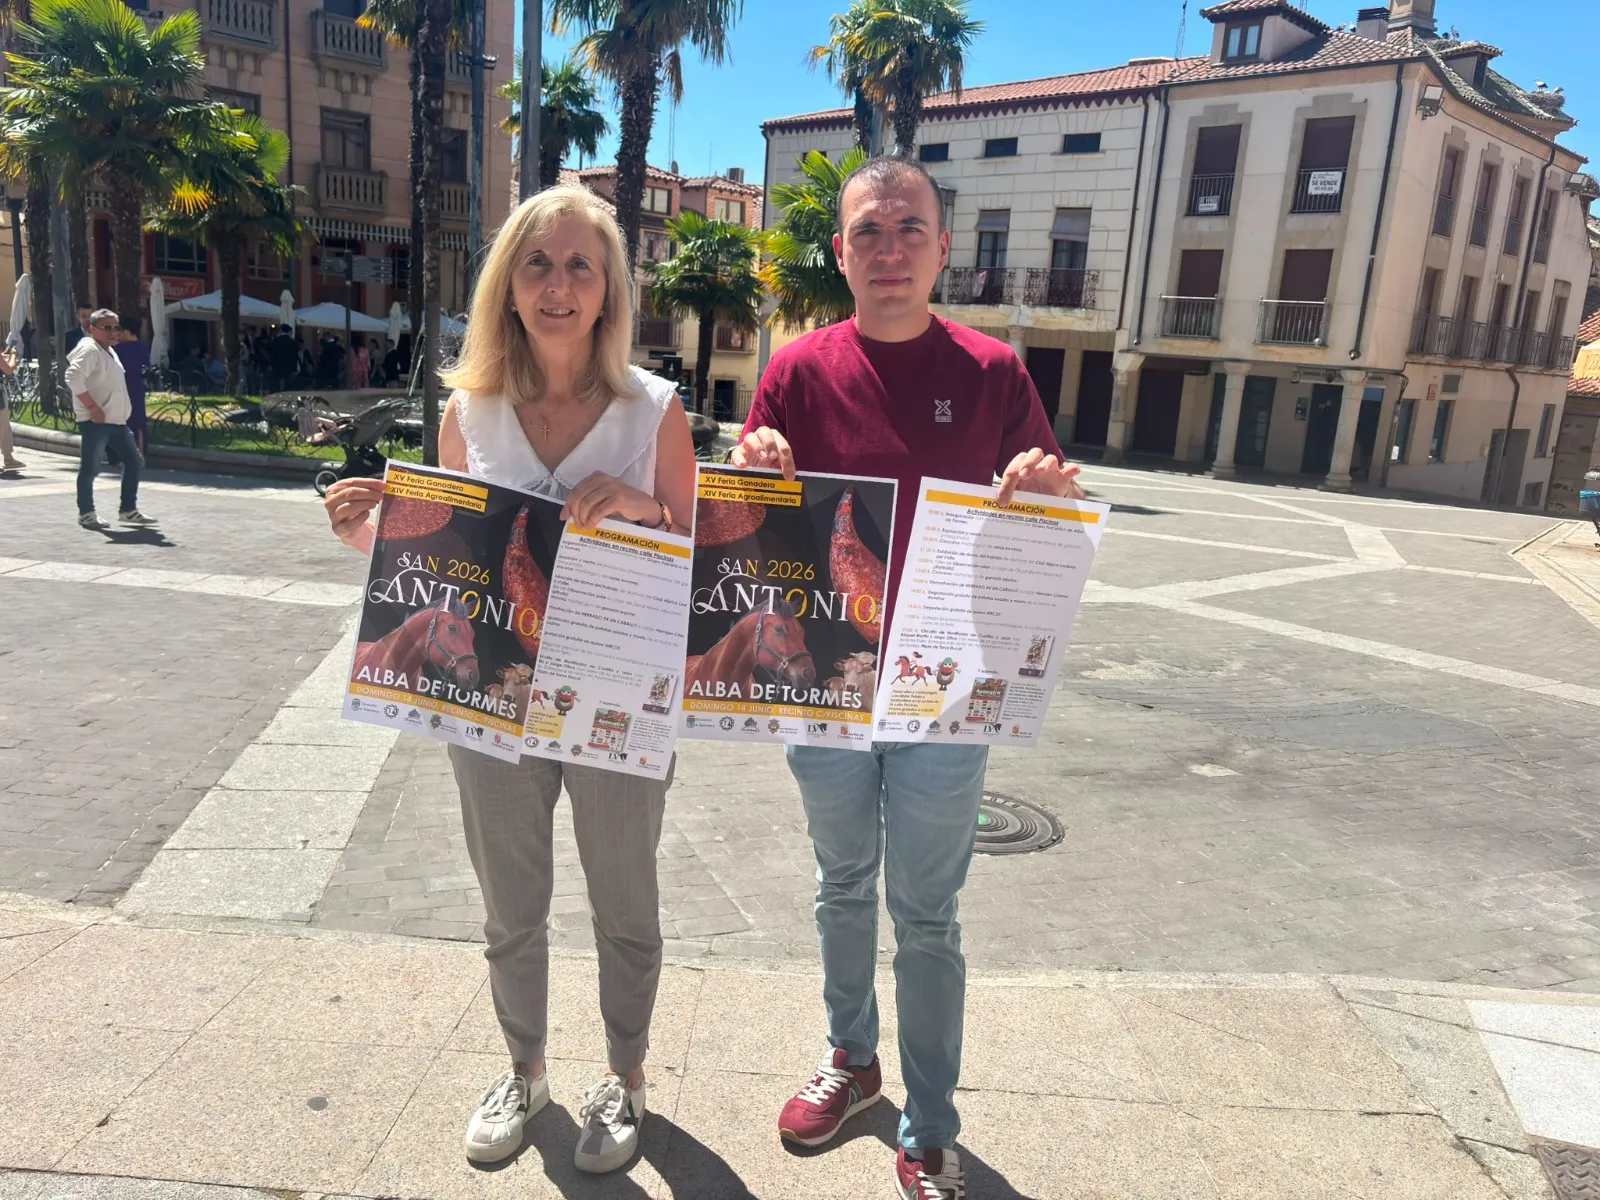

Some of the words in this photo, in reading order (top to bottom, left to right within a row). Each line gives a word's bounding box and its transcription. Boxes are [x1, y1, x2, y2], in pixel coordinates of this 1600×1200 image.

[407, 477, 425, 486] Feria
[426, 479, 464, 492] Ganadera
[737, 479, 775, 489] Ganadera
[406, 488, 424, 498] Feria
[425, 492, 482, 510] Agroalimentaria
[718, 491, 736, 499] Feria
[738, 493, 797, 504] Agroalimentaria
[967, 508, 998, 518] Actividades
[579, 537, 610, 548] Actividades
[620, 545, 638, 554] recinto
[654, 553, 674, 562] Piscinas
[596, 530, 659, 550] PROGRAMACIÓN
[397, 551, 440, 573] SAN
[447, 560, 490, 585] 2026
[717, 558, 760, 576] SAN
[767, 560, 815, 580] 2026
[368, 568, 539, 636] ANTONIO
[692, 574, 877, 623] ANTONIO
[617, 619, 637, 628] CABALLO
[356, 686, 400, 700] DOMINGO
[442, 705, 474, 718] RECINTO
[357, 666, 409, 689] ALBA
[417, 677, 442, 696] DE
[447, 683, 518, 720] TORMES
[689, 680, 742, 699] ALBA
[750, 683, 776, 700] DE
[781, 686, 862, 709] TORMES
[690, 702, 734, 711] DOMINGO
[779, 707, 813, 716] RECINTO
[816, 711, 864, 721] C/PISCINAS
